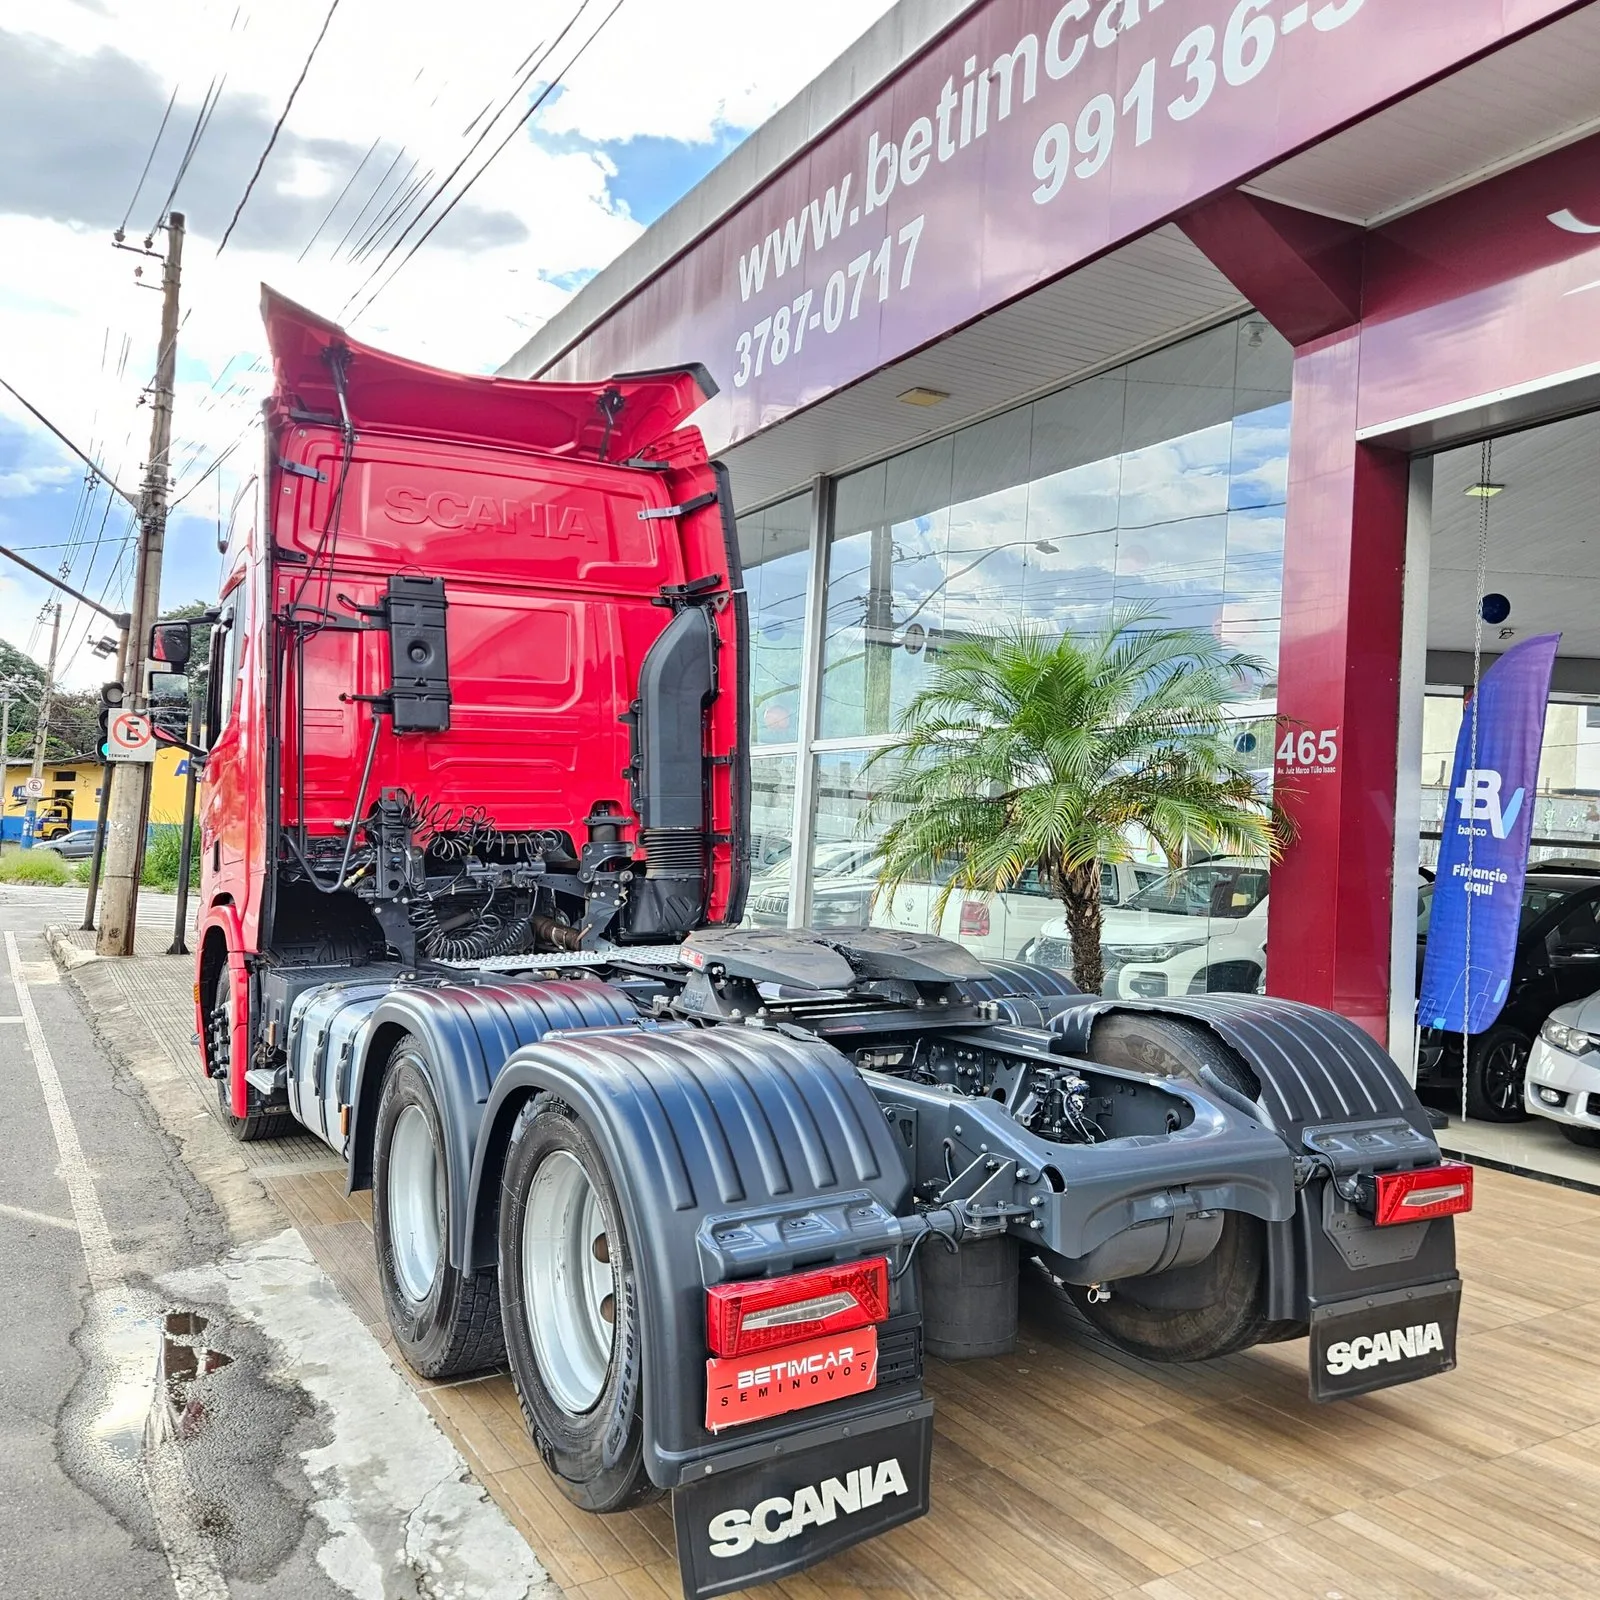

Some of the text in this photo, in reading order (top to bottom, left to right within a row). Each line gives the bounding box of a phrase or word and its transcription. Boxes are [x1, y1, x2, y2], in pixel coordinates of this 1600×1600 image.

[738, 0, 1164, 303] www.betimca
[733, 214, 925, 388] 3787-0717
[384, 486, 598, 544] SCANIA
[1276, 729, 1337, 765] 465
[1457, 825, 1487, 837] banco
[1452, 863, 1508, 883] Financie
[1464, 881, 1494, 896] aqui
[737, 1347, 854, 1389] BETIMCAR
[1326, 1322, 1444, 1375] SCANIA
[721, 1362, 867, 1406] SEMINOVOS
[708, 1458, 909, 1558] SCANIA
